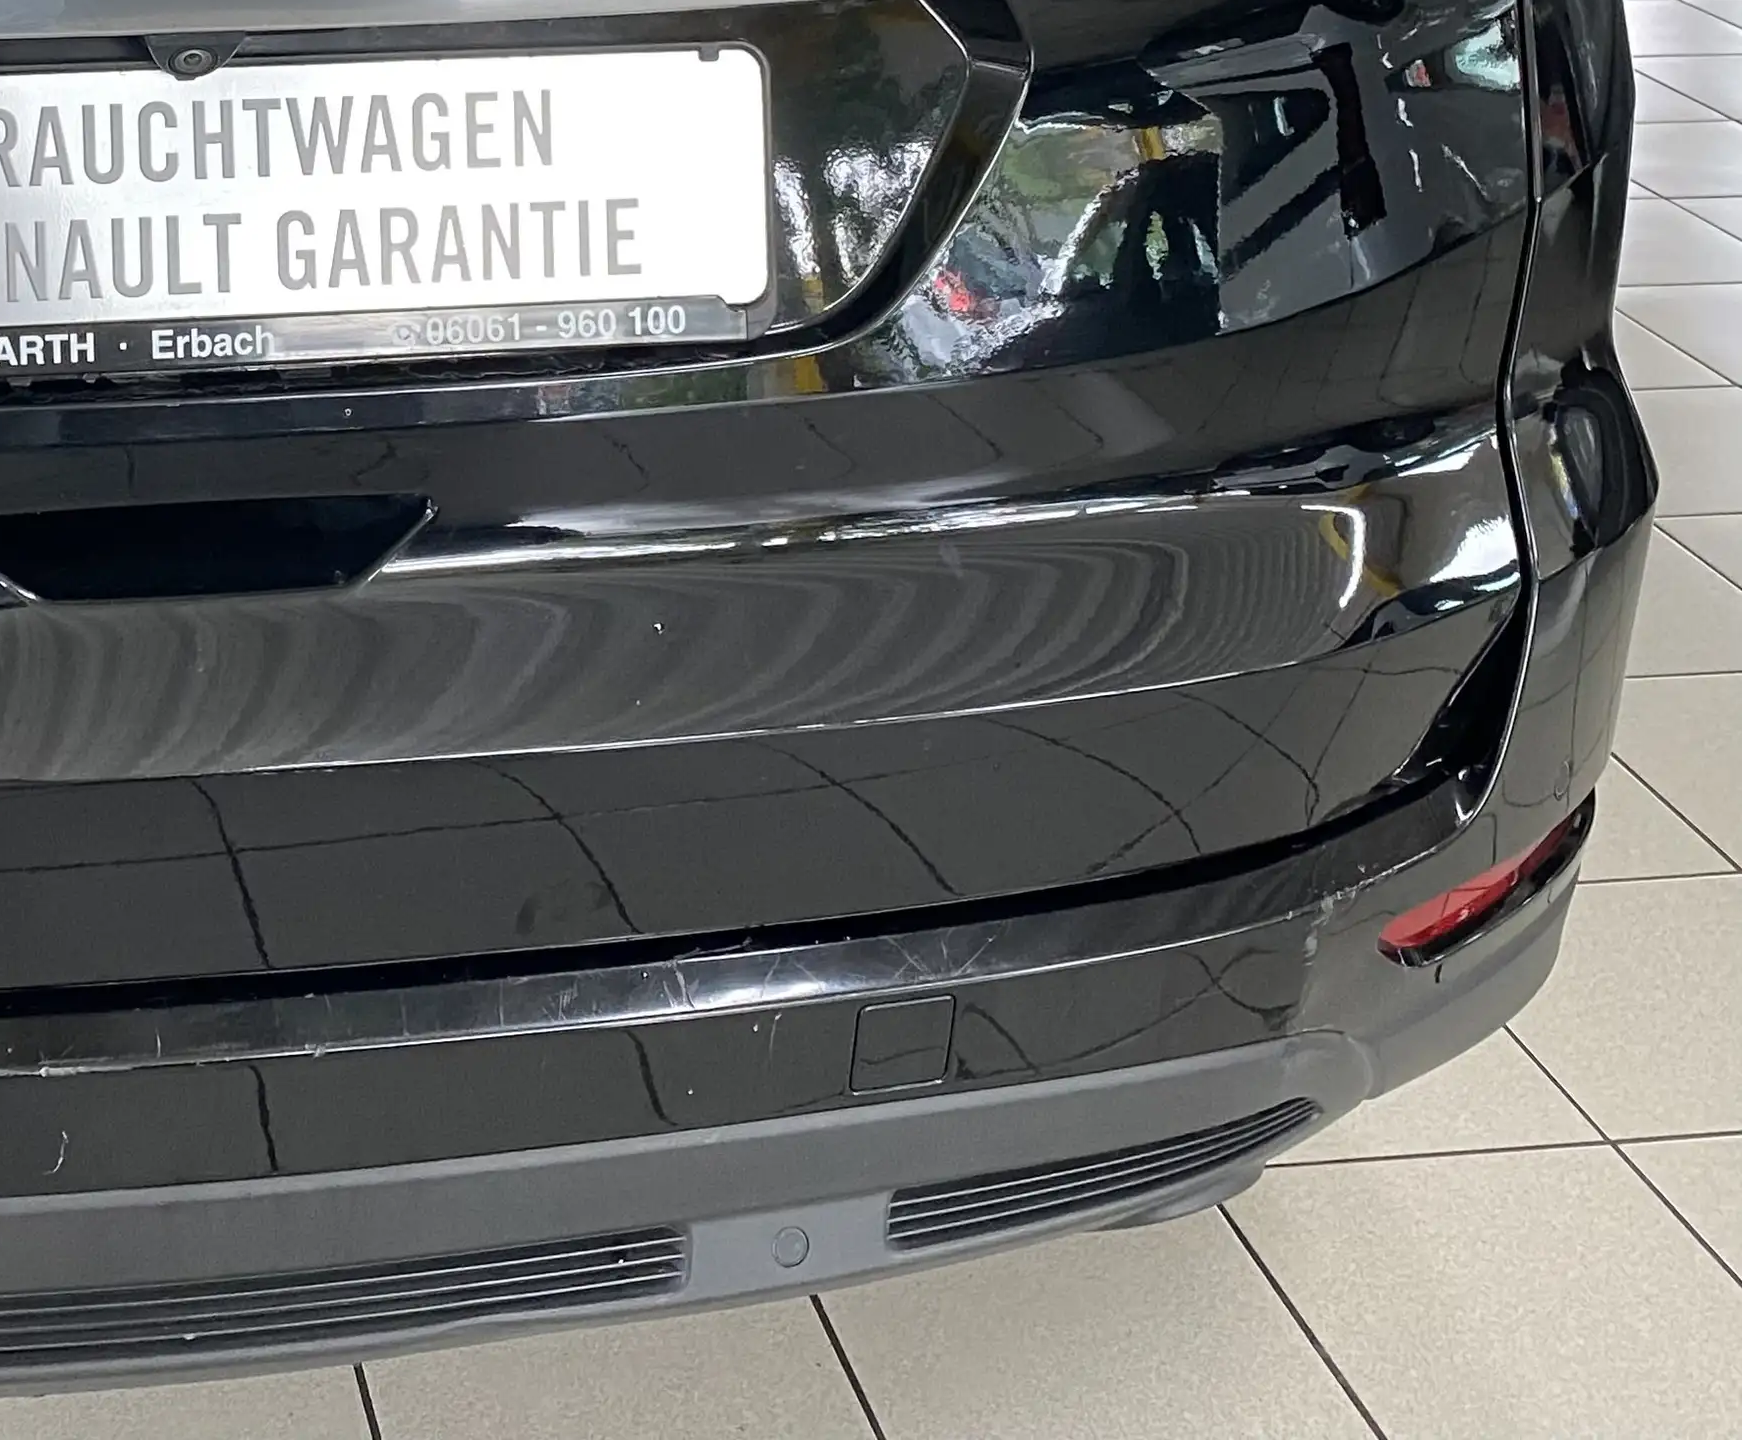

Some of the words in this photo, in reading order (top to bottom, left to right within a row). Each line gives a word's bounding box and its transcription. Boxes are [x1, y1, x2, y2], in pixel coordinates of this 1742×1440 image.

[276, 197, 642, 290] GARANTIE
[151, 325, 276, 360] Erbach
[425, 312, 522, 346] 06061
[558, 309, 617, 340] 960
[628, 304, 686, 336] 100
